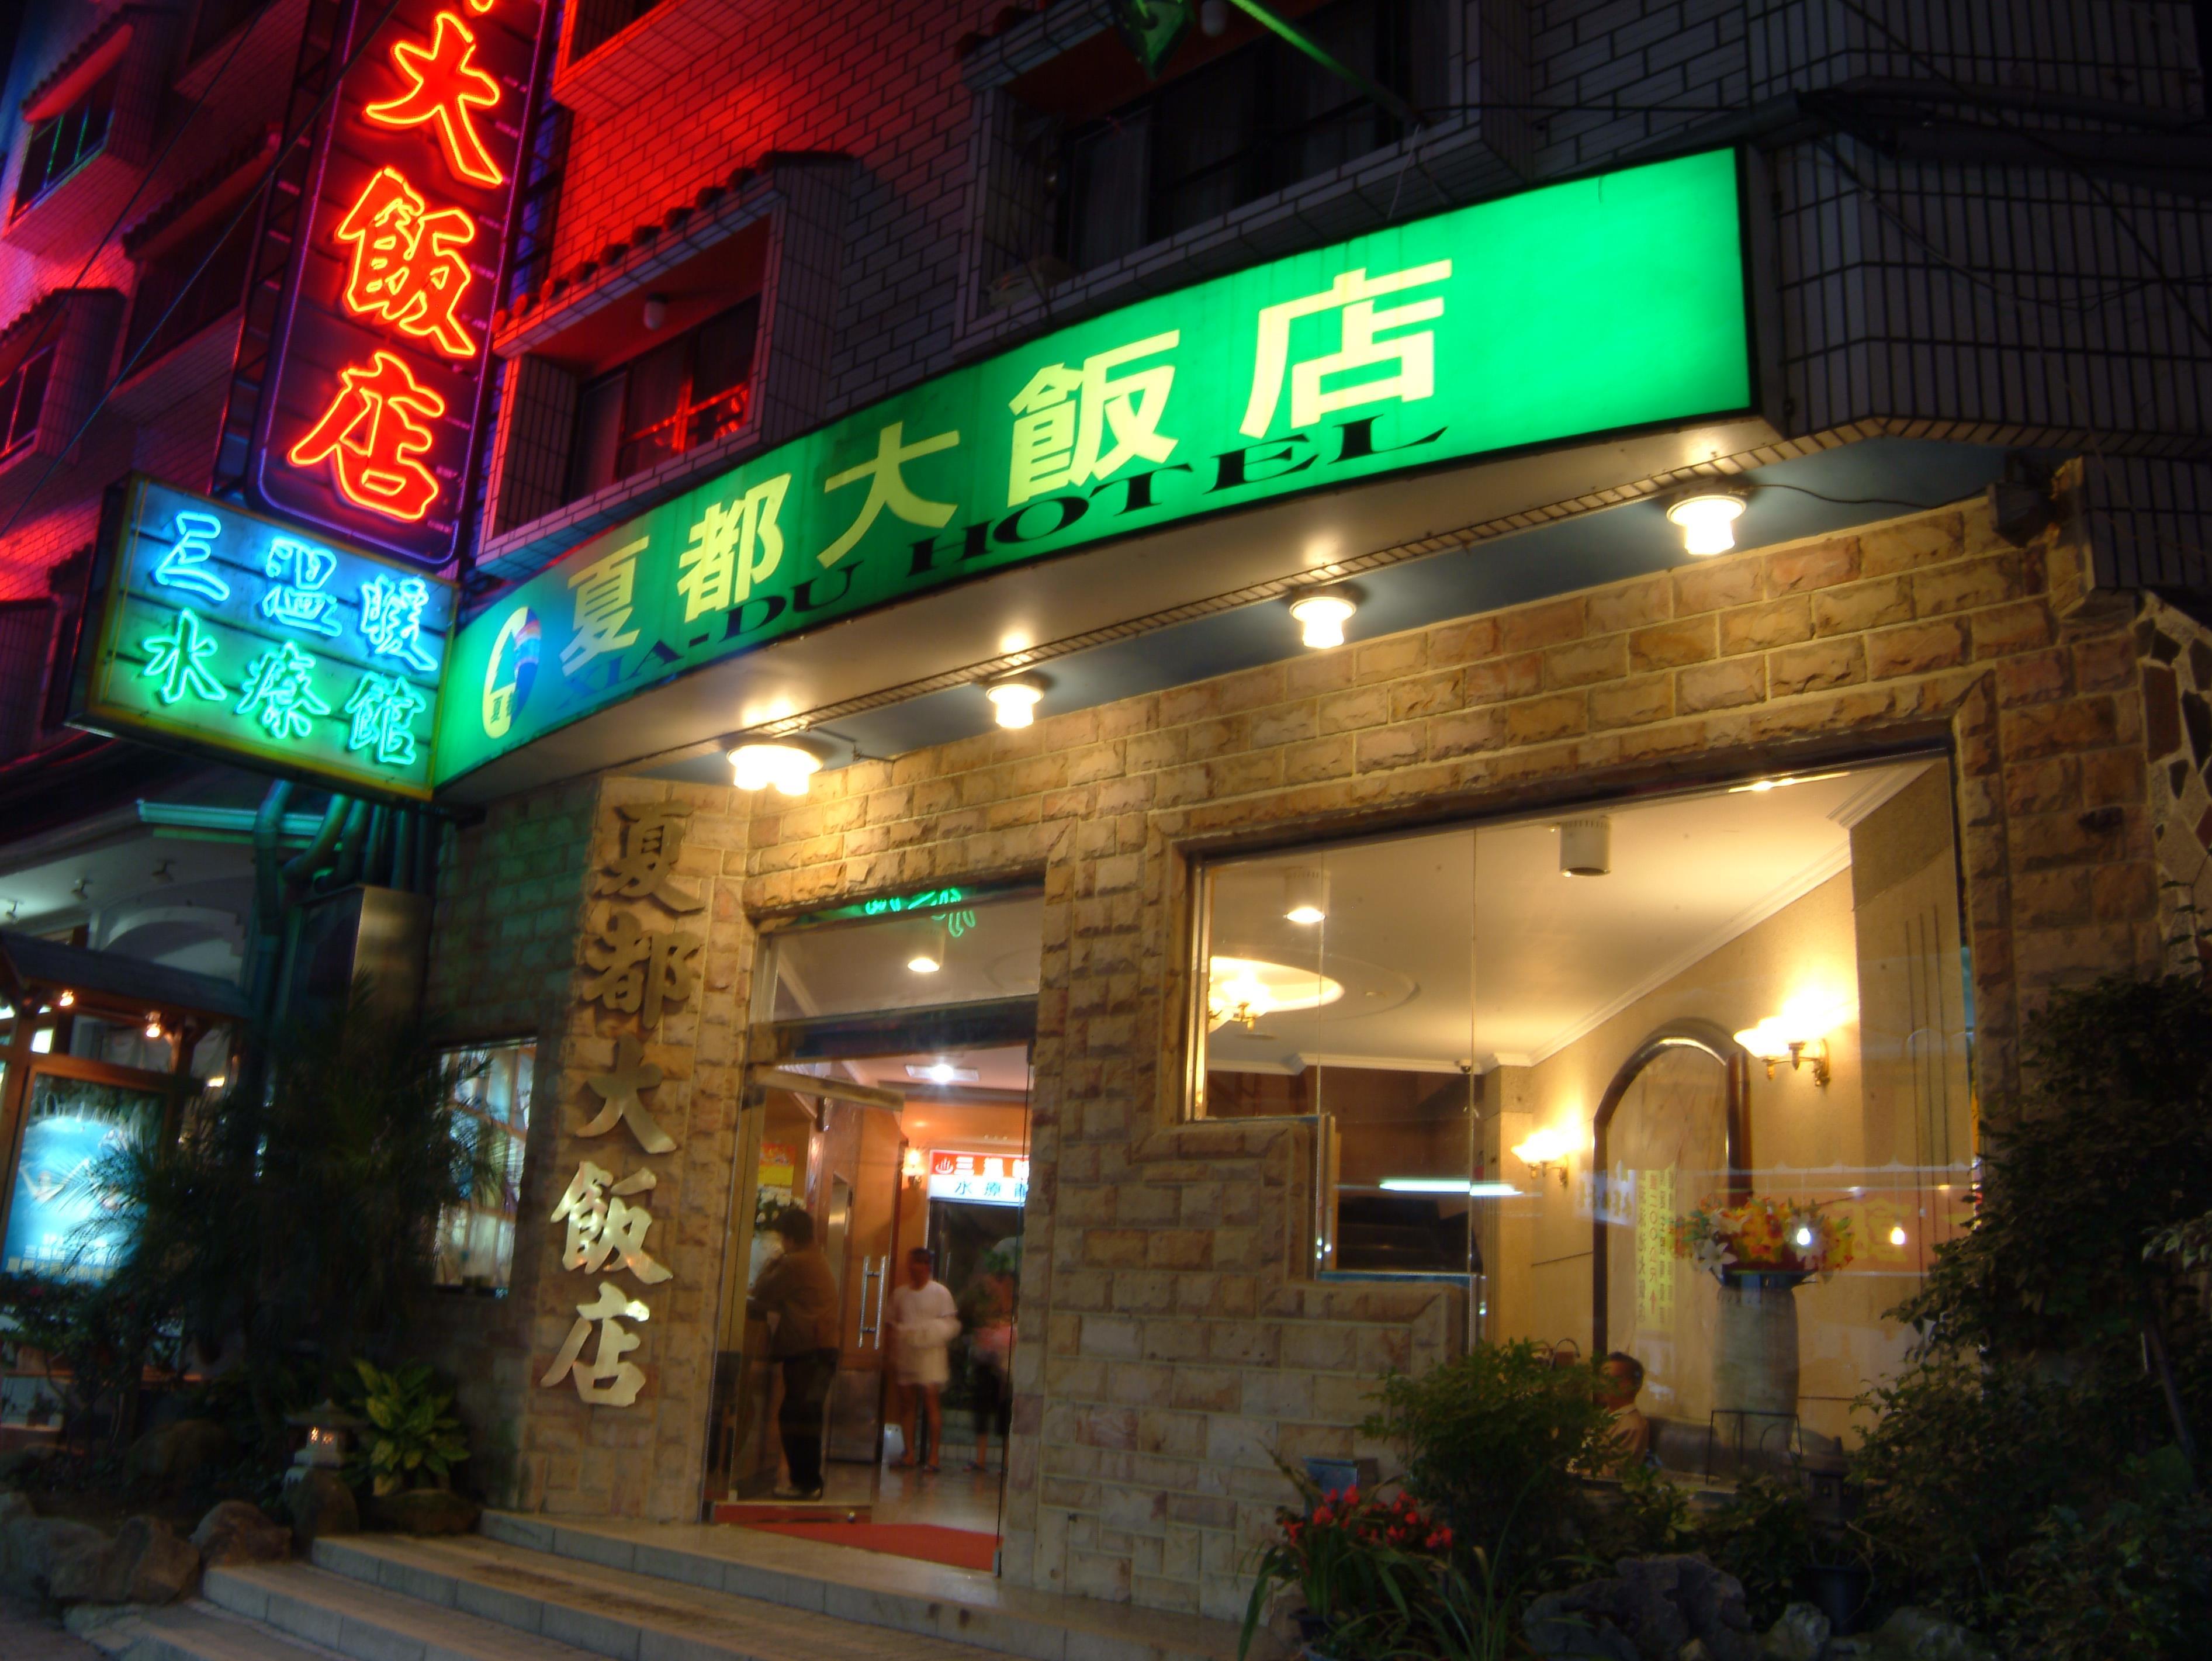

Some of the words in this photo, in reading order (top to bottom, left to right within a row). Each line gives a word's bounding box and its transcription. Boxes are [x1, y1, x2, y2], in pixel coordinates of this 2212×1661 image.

[289, 0, 504, 522] 大飯店
[559, 258, 1452, 677] 夏都大飯店
[142, 608, 428, 766] 水療館
[555, 559, 865, 711] XIA-DU
[906, 413, 1449, 578] HOTEL
[541, 799, 706, 1407] 夏都大飯店
